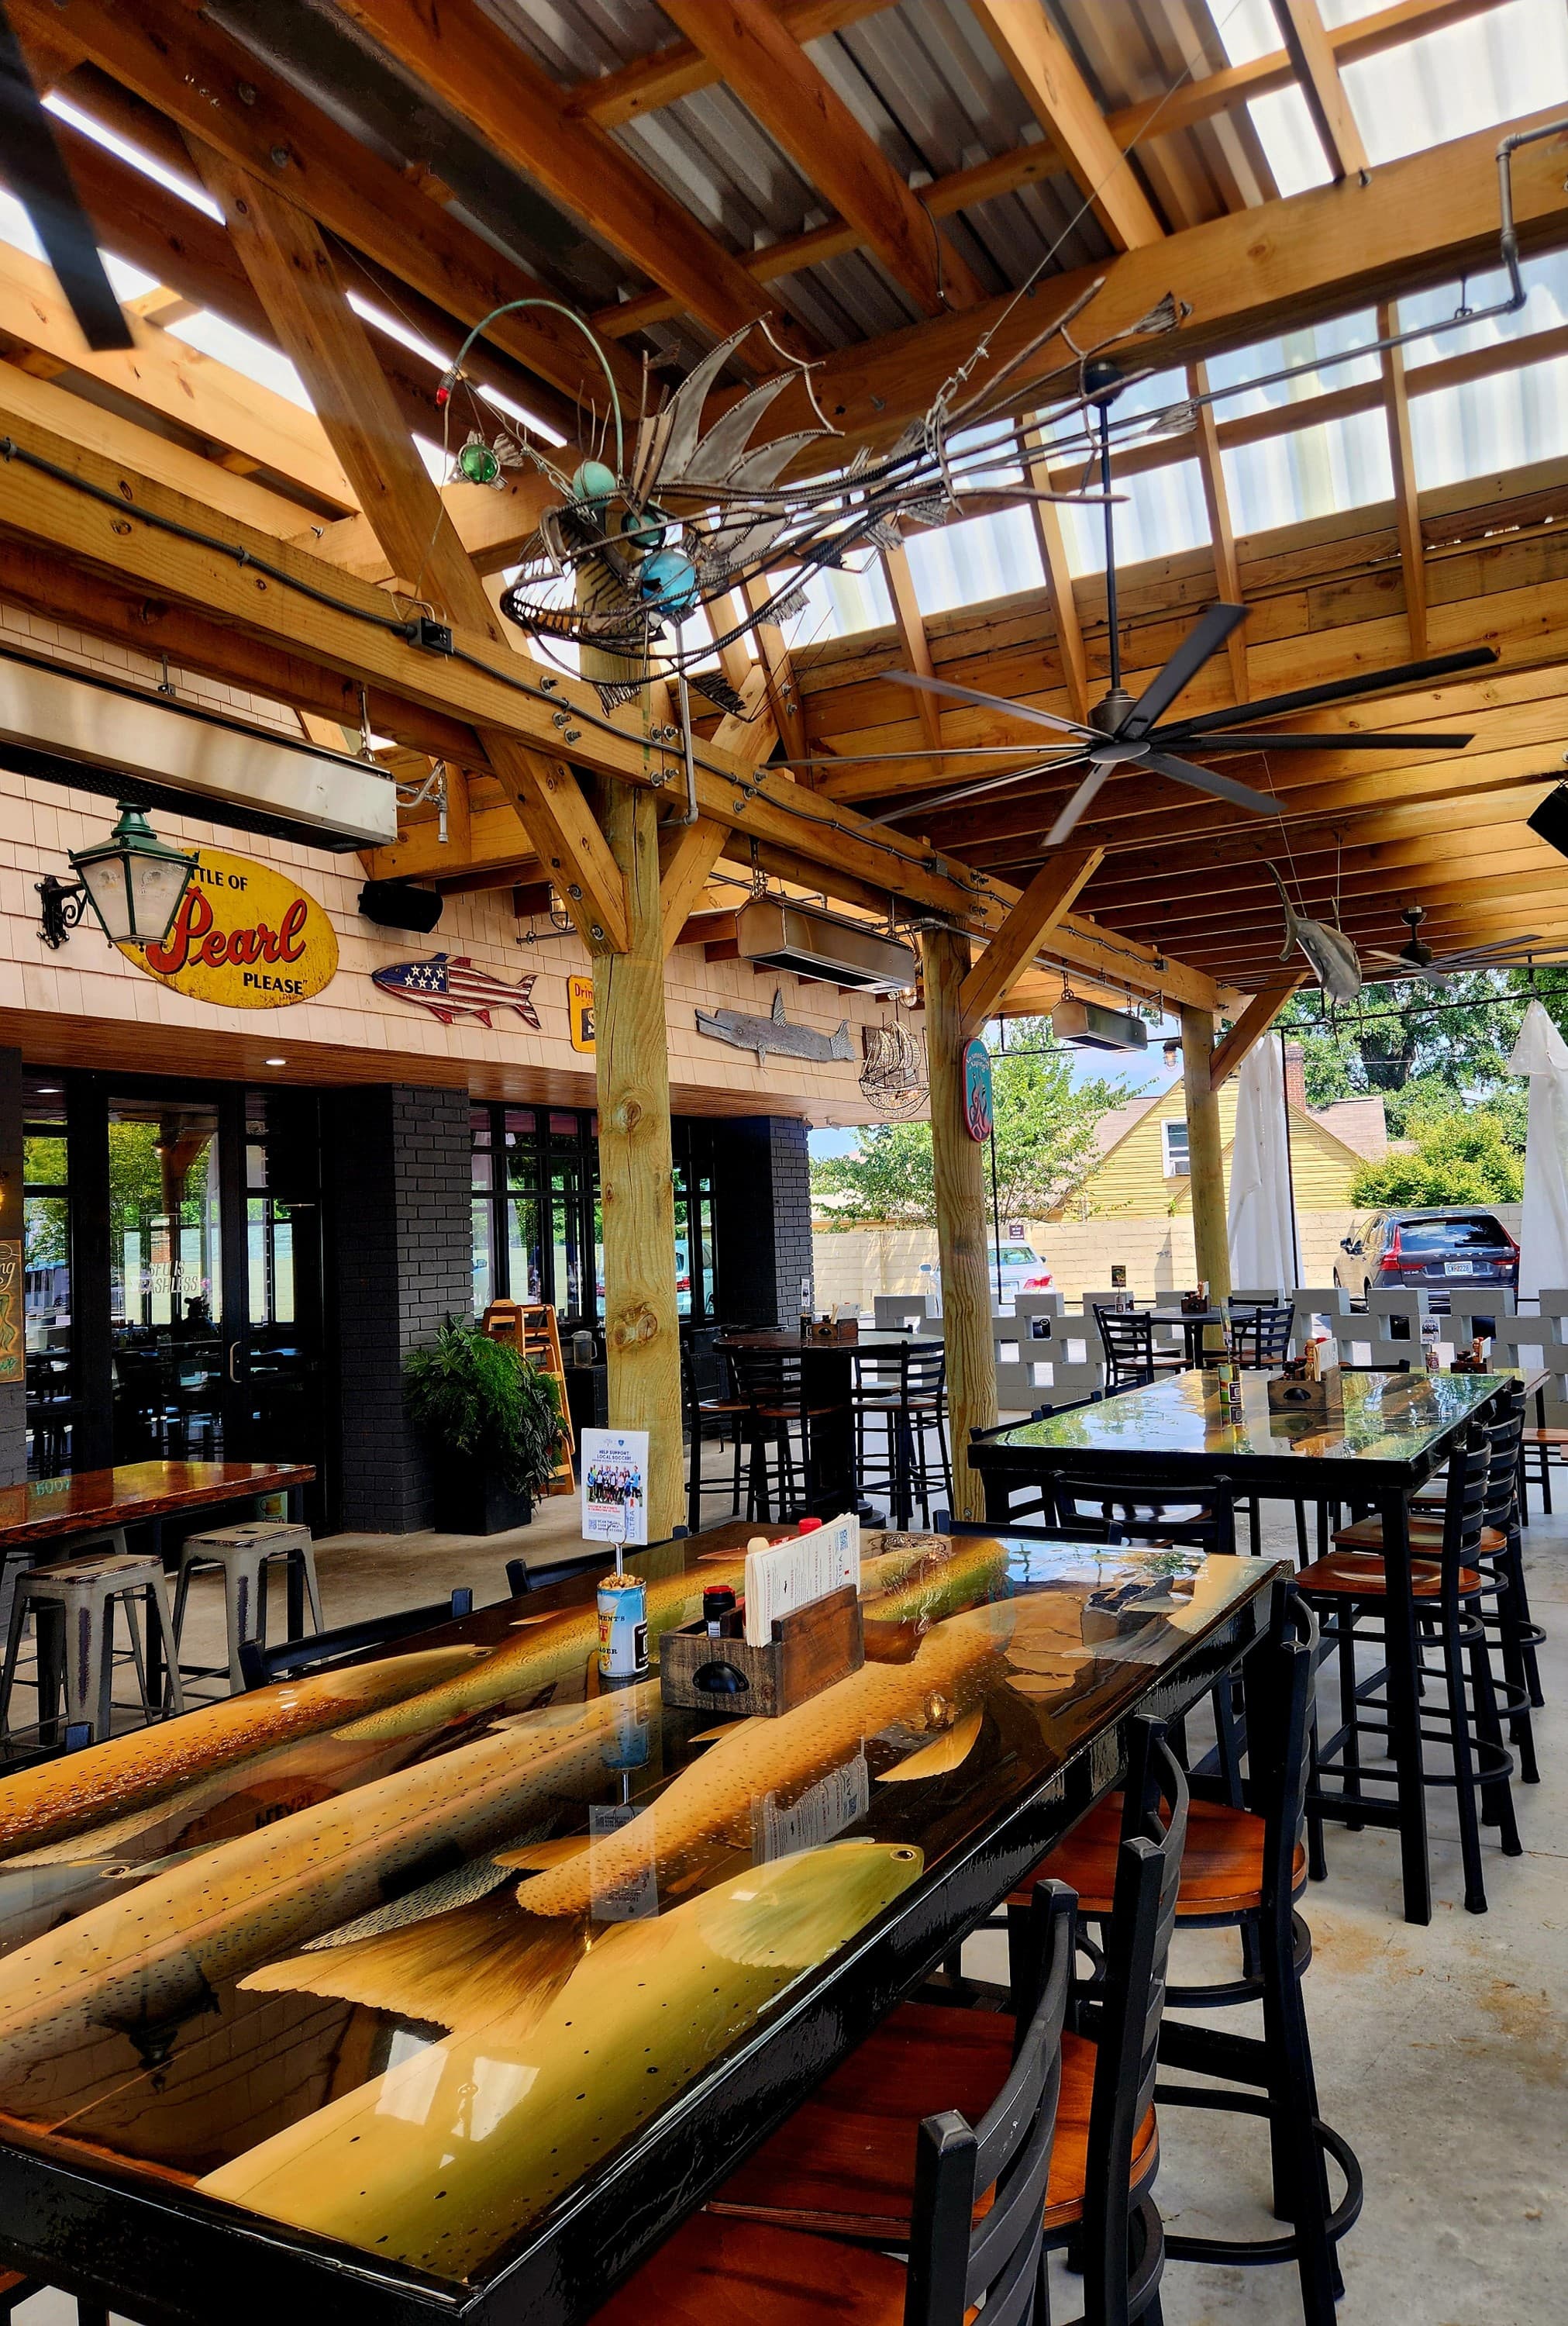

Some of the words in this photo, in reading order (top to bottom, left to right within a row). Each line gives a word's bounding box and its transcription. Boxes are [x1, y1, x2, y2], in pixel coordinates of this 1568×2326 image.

[228, 875, 248, 892] OF
[145, 885, 308, 975] Pearl
[574, 983, 593, 999] Drin
